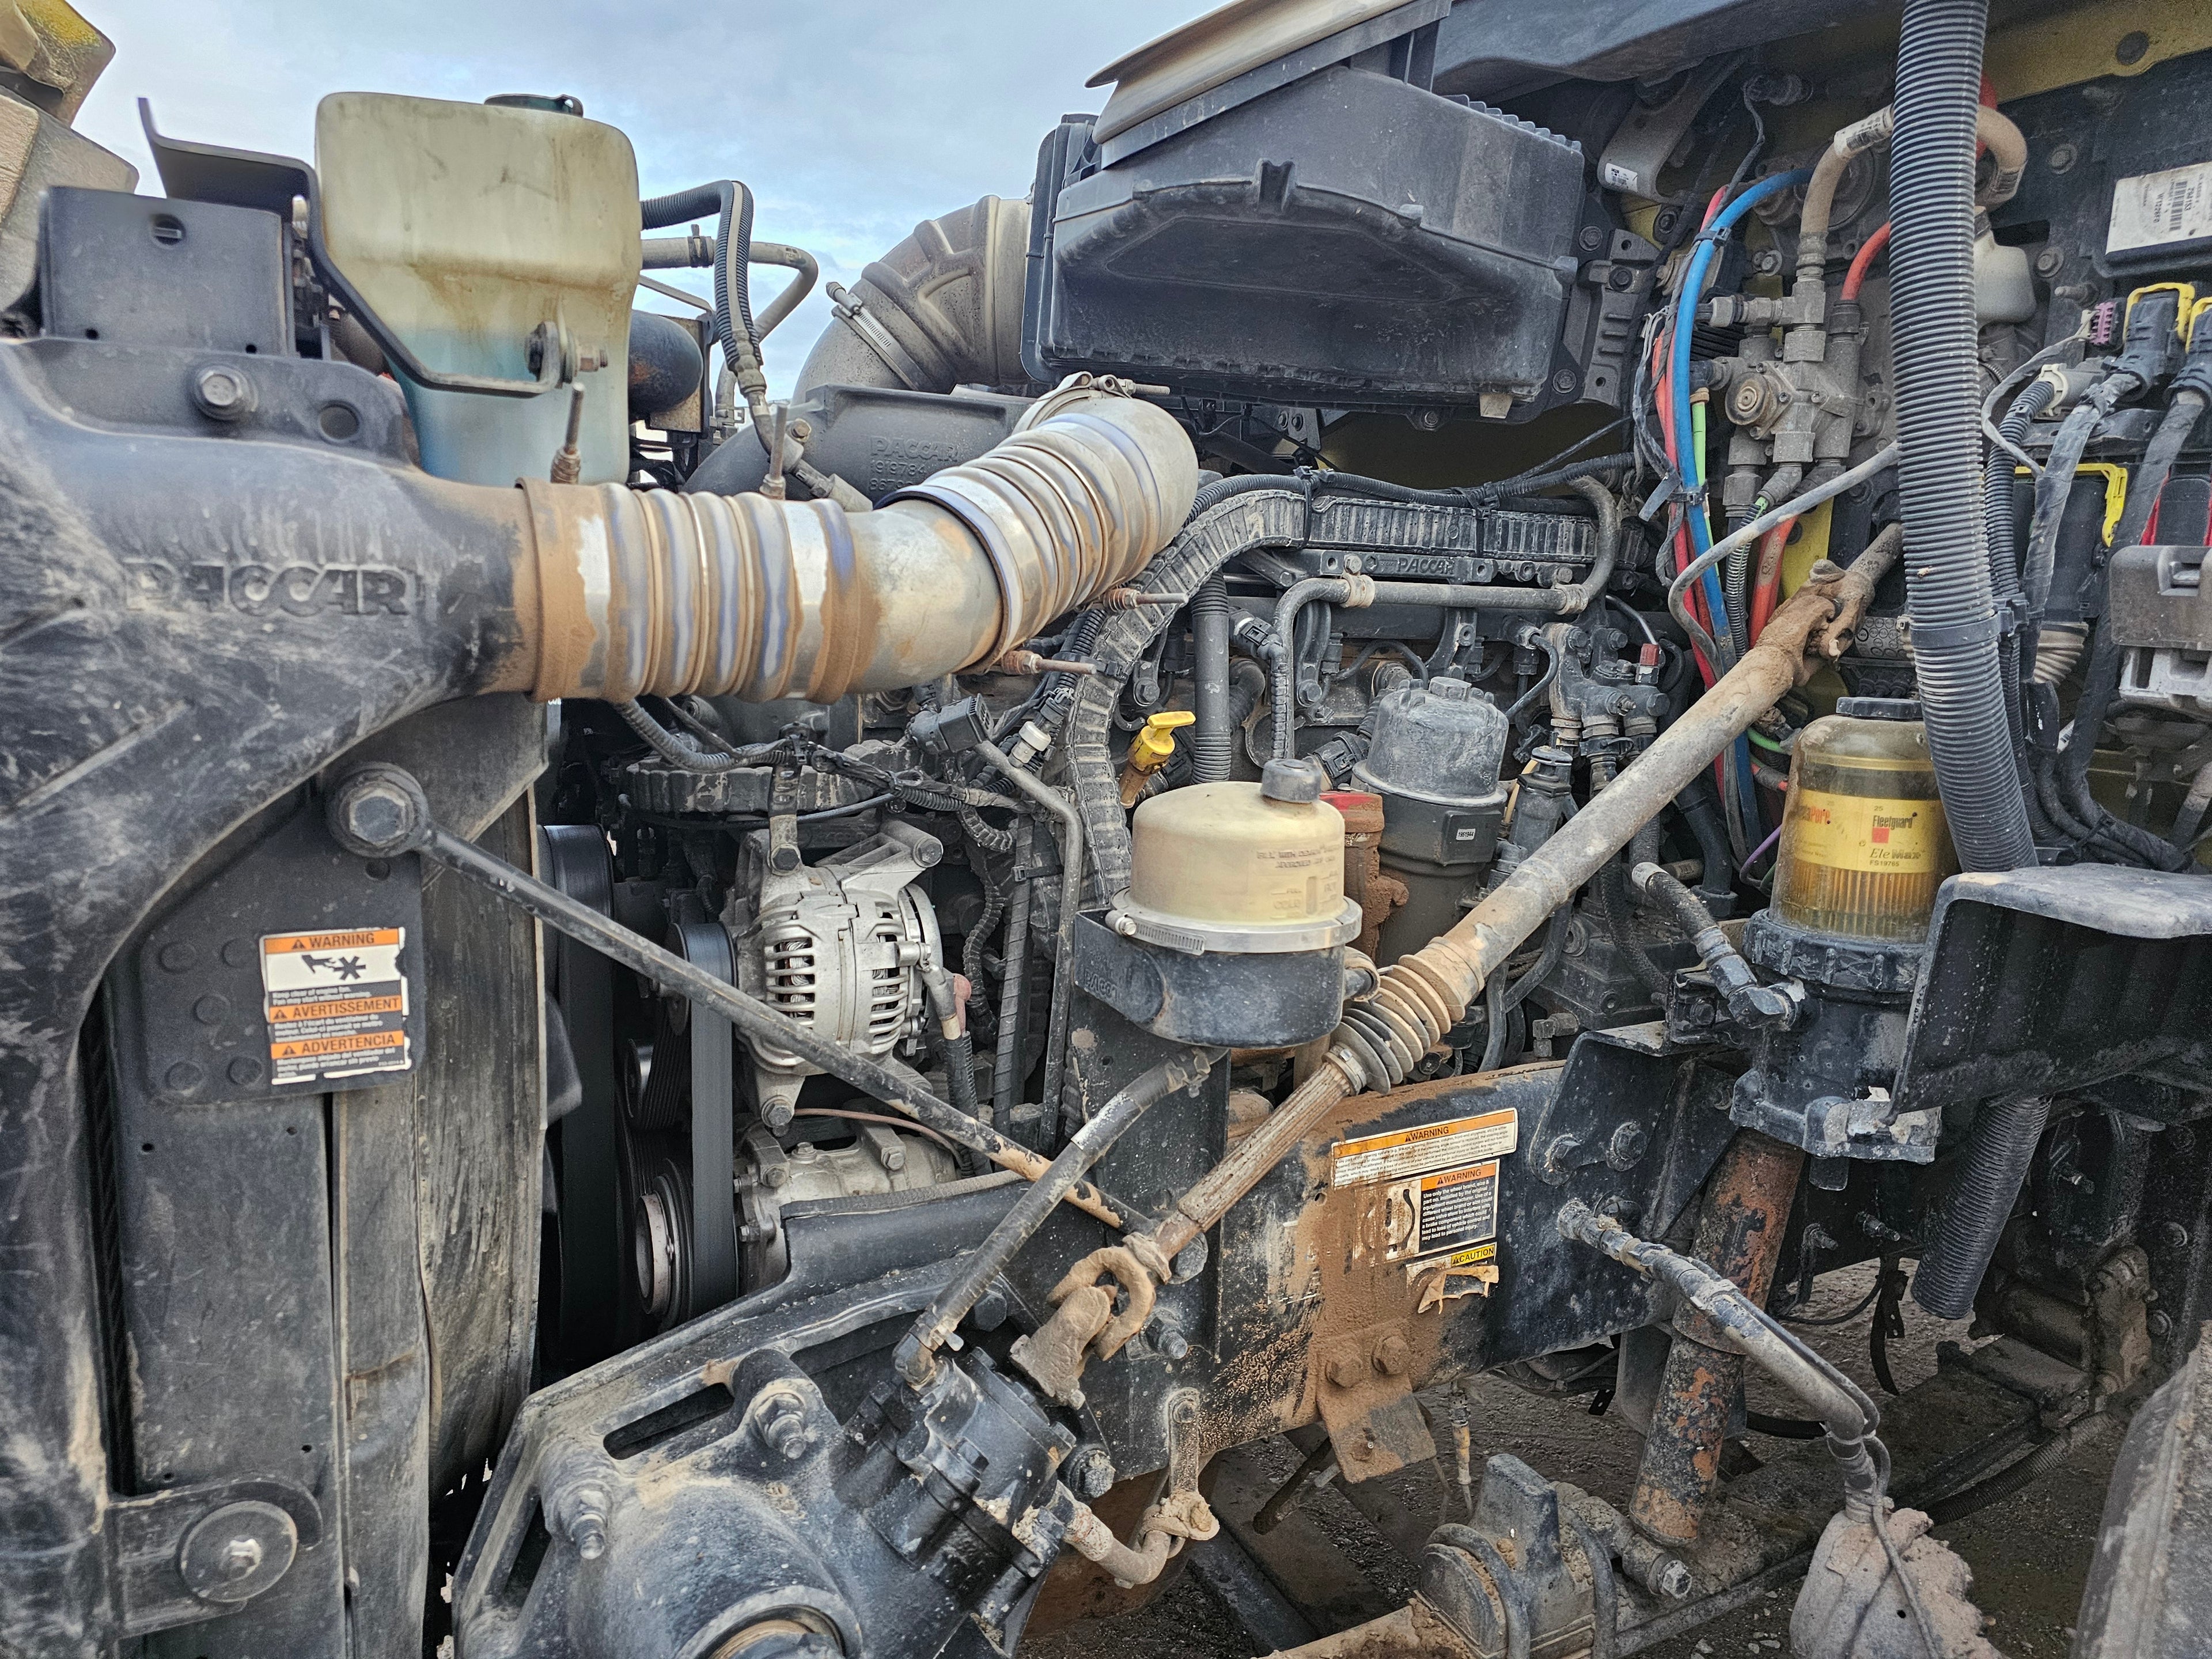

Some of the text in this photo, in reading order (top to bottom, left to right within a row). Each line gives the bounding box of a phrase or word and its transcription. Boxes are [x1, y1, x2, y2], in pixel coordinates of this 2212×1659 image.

[870, 435, 959, 462] PACCAR
[1397, 557, 1455, 575] PACCAR
[122, 556, 412, 616] PACCAR
[1873, 815, 1913, 830] Fleetguard
[309, 933, 374, 948] WARNING
[293, 997, 399, 1018] AVERTISSEMENT
[302, 1034, 396, 1054] ADVERTENCIA
[1410, 1126, 1449, 1141] WARNING
[1445, 1169, 1482, 1183] WARNING
[1459, 1247, 1494, 1263] CAUTION
